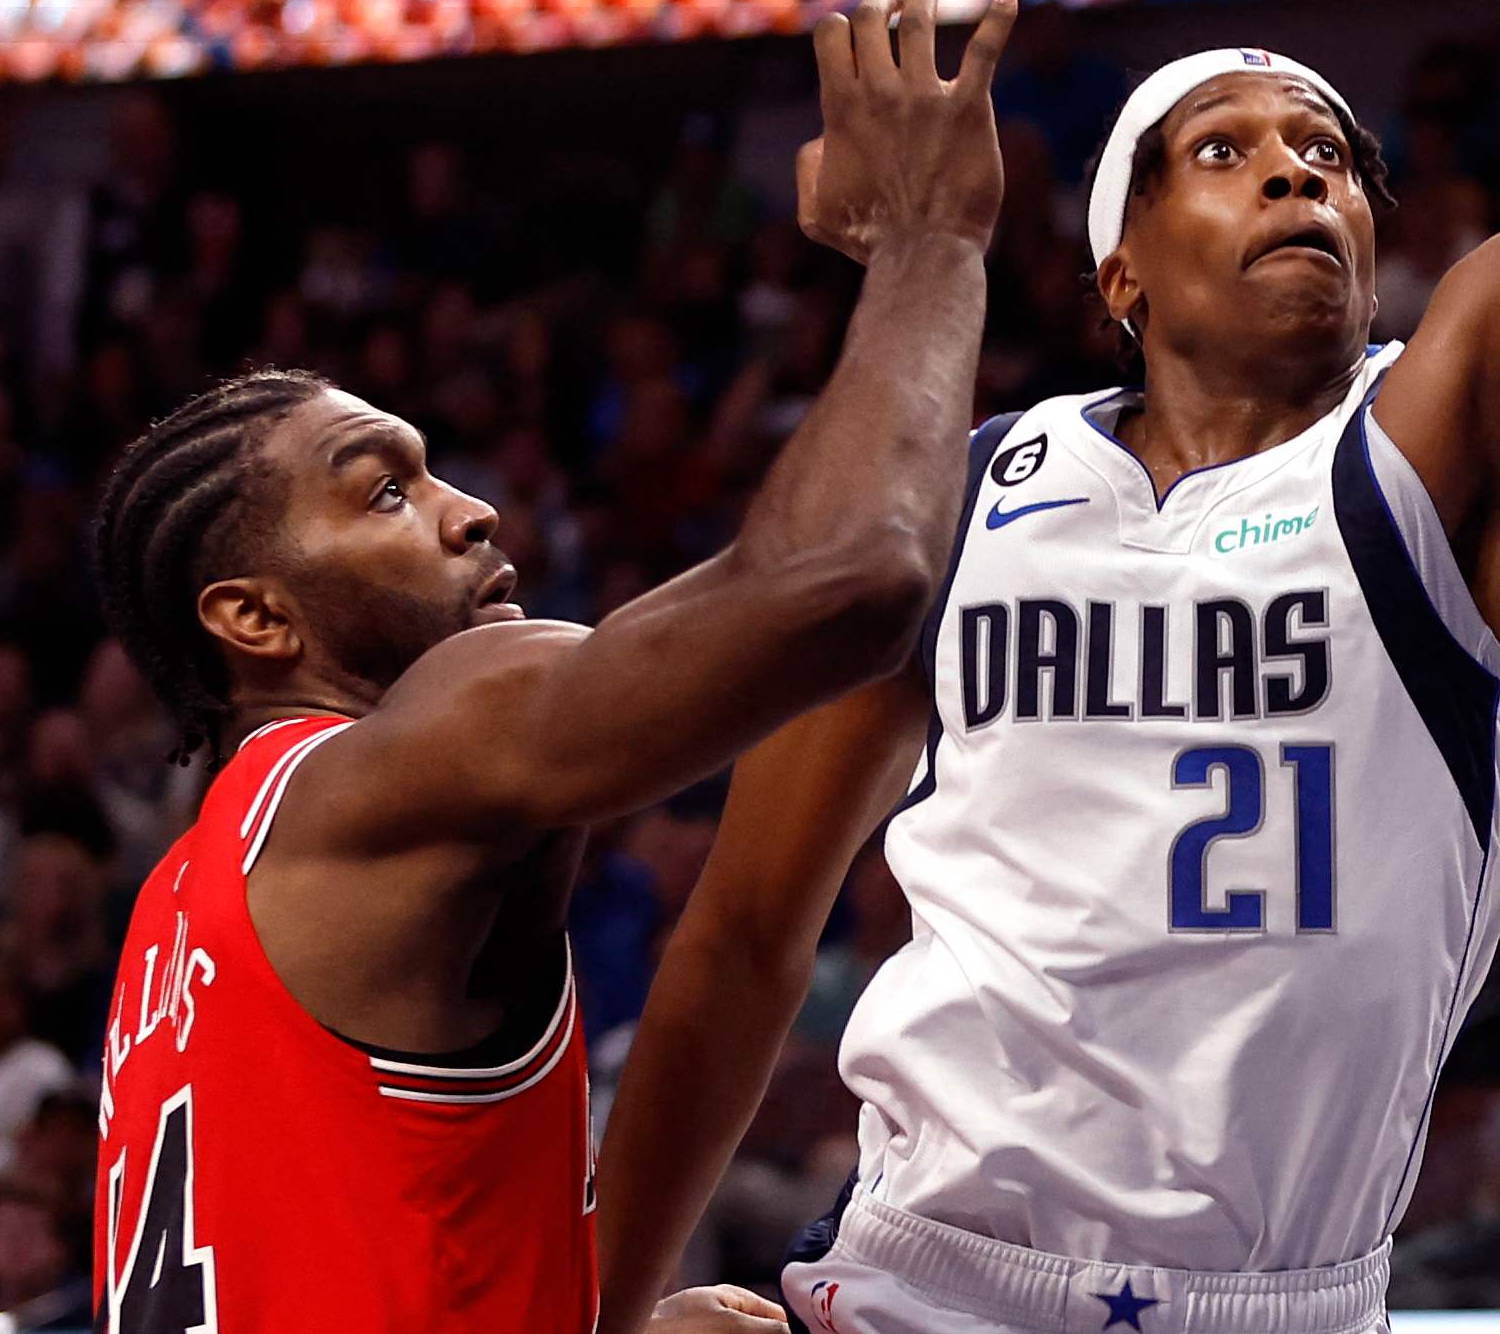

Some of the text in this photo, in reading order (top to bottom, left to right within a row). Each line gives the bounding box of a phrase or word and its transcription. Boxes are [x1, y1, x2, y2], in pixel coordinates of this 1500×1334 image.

[1003, 443, 1042, 482] 6
[1215, 506, 1320, 553] chime
[959, 586, 1332, 733] DALLAS
[1167, 741, 1337, 935] 21
